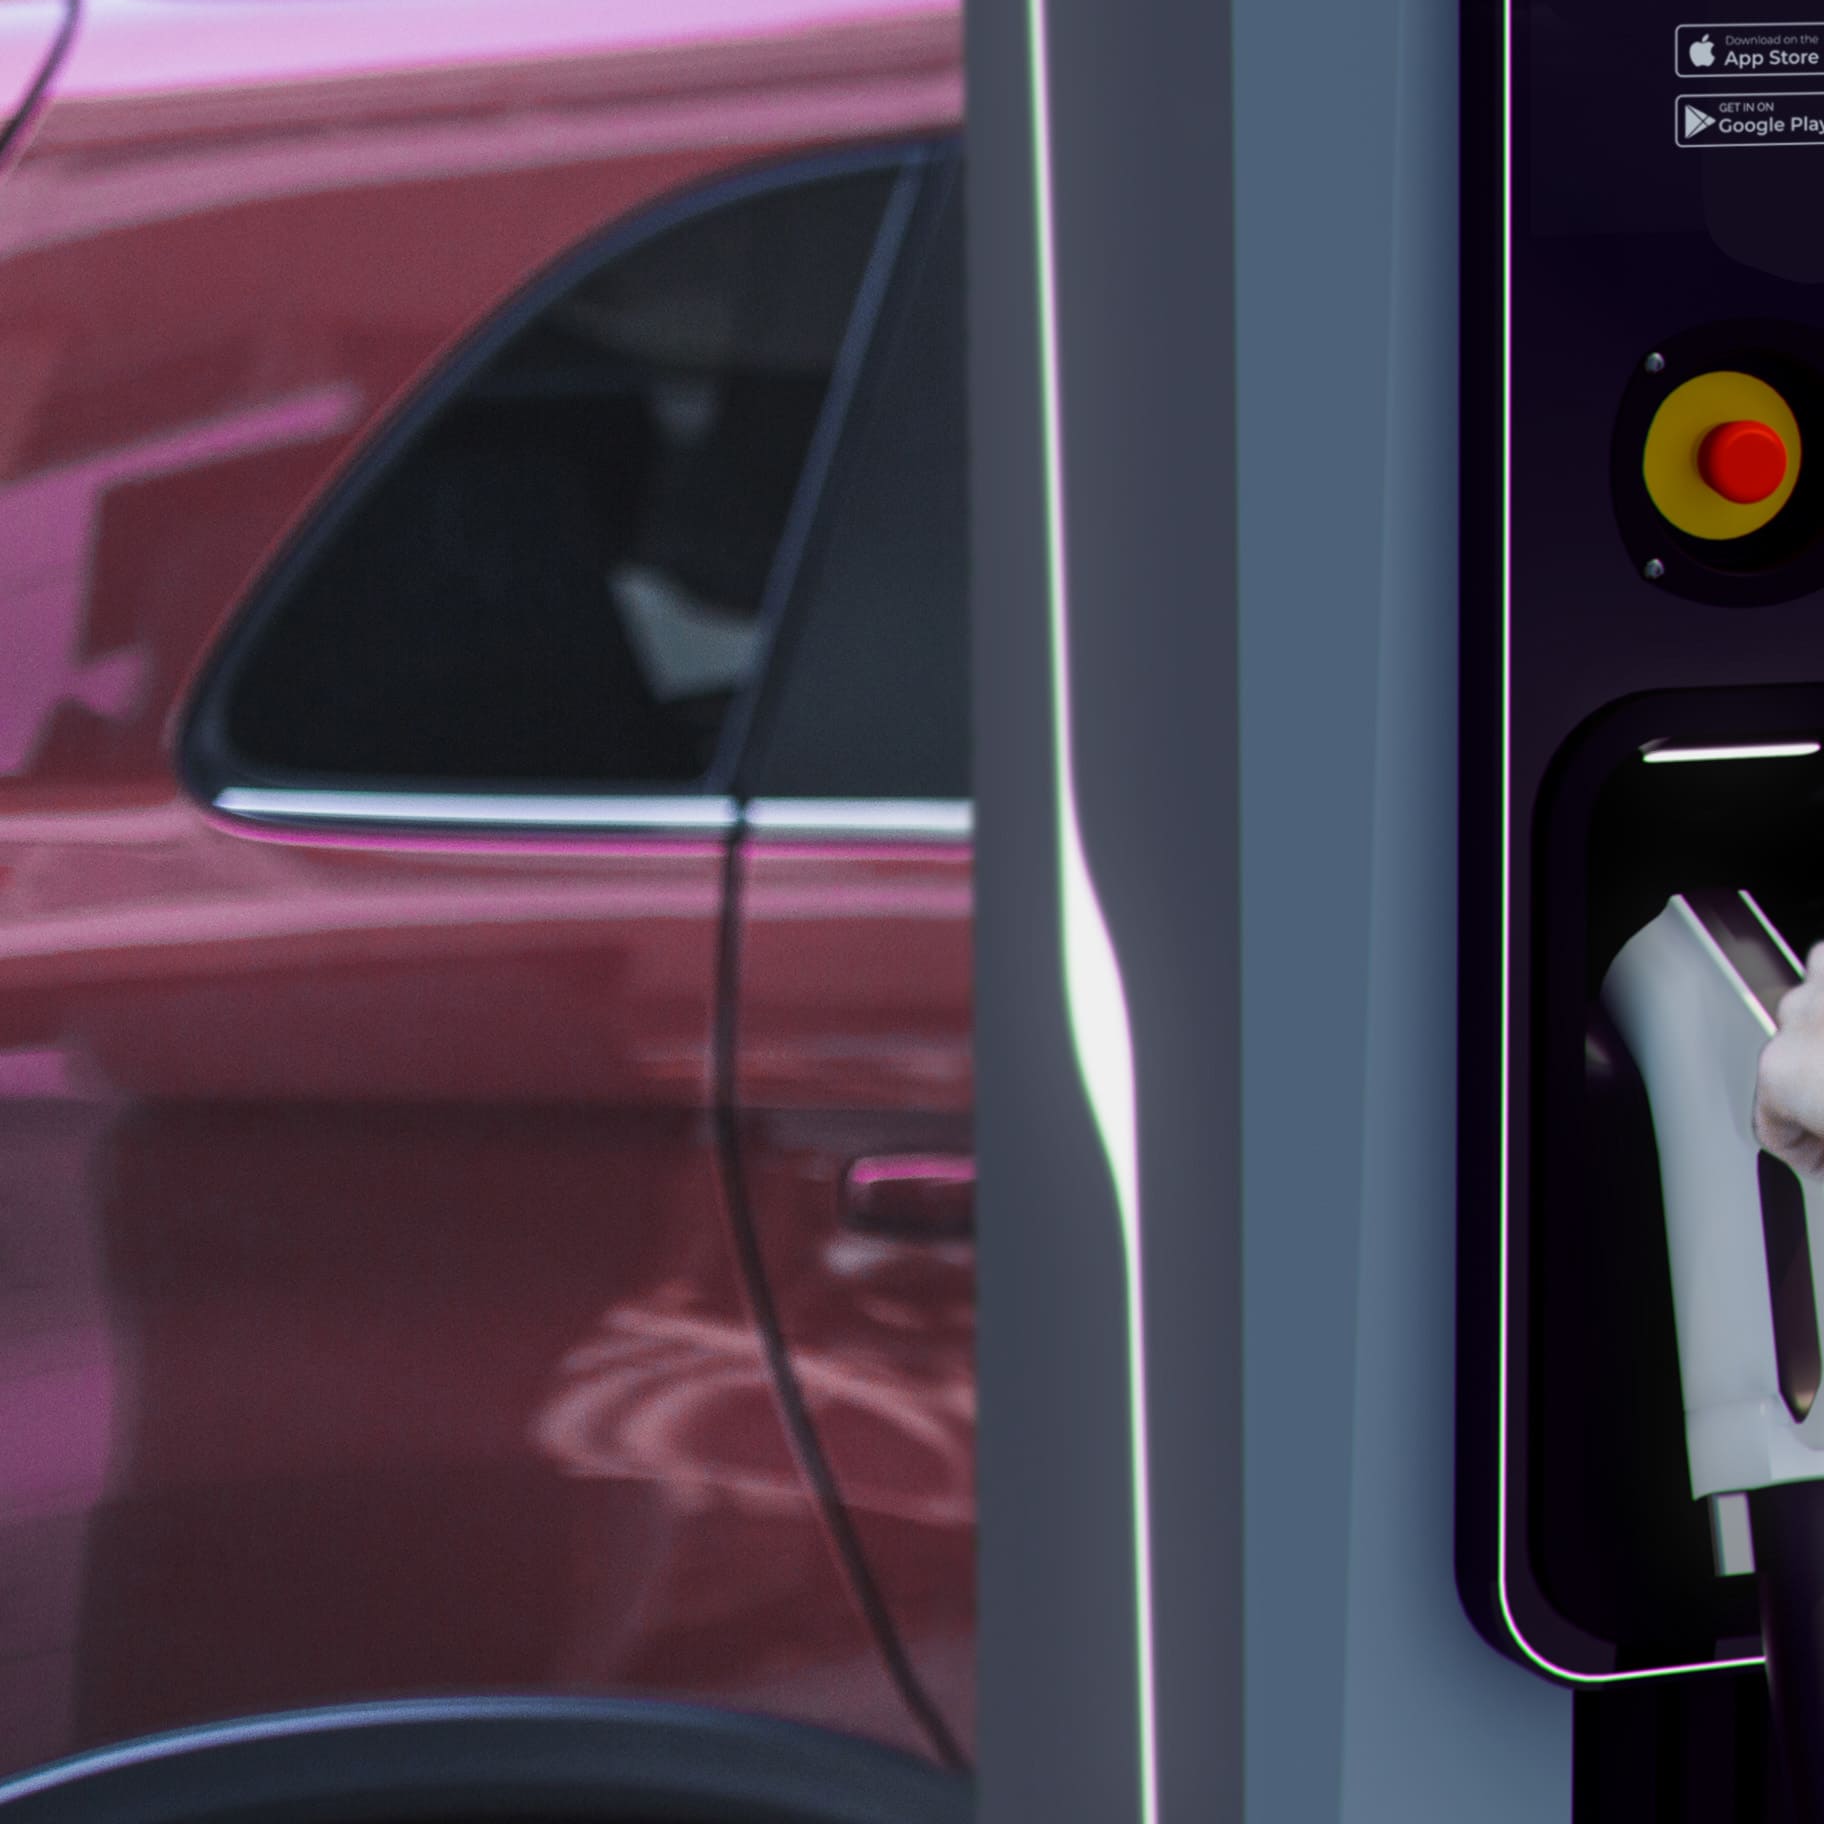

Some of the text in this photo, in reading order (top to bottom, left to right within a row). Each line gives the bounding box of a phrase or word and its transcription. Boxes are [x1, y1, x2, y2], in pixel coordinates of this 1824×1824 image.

[1725, 34, 1819, 46] Download on the
[1724, 50, 1819, 69] App Store
[1718, 102, 1774, 113] GET IN ON
[1718, 116, 1785, 136] Google
